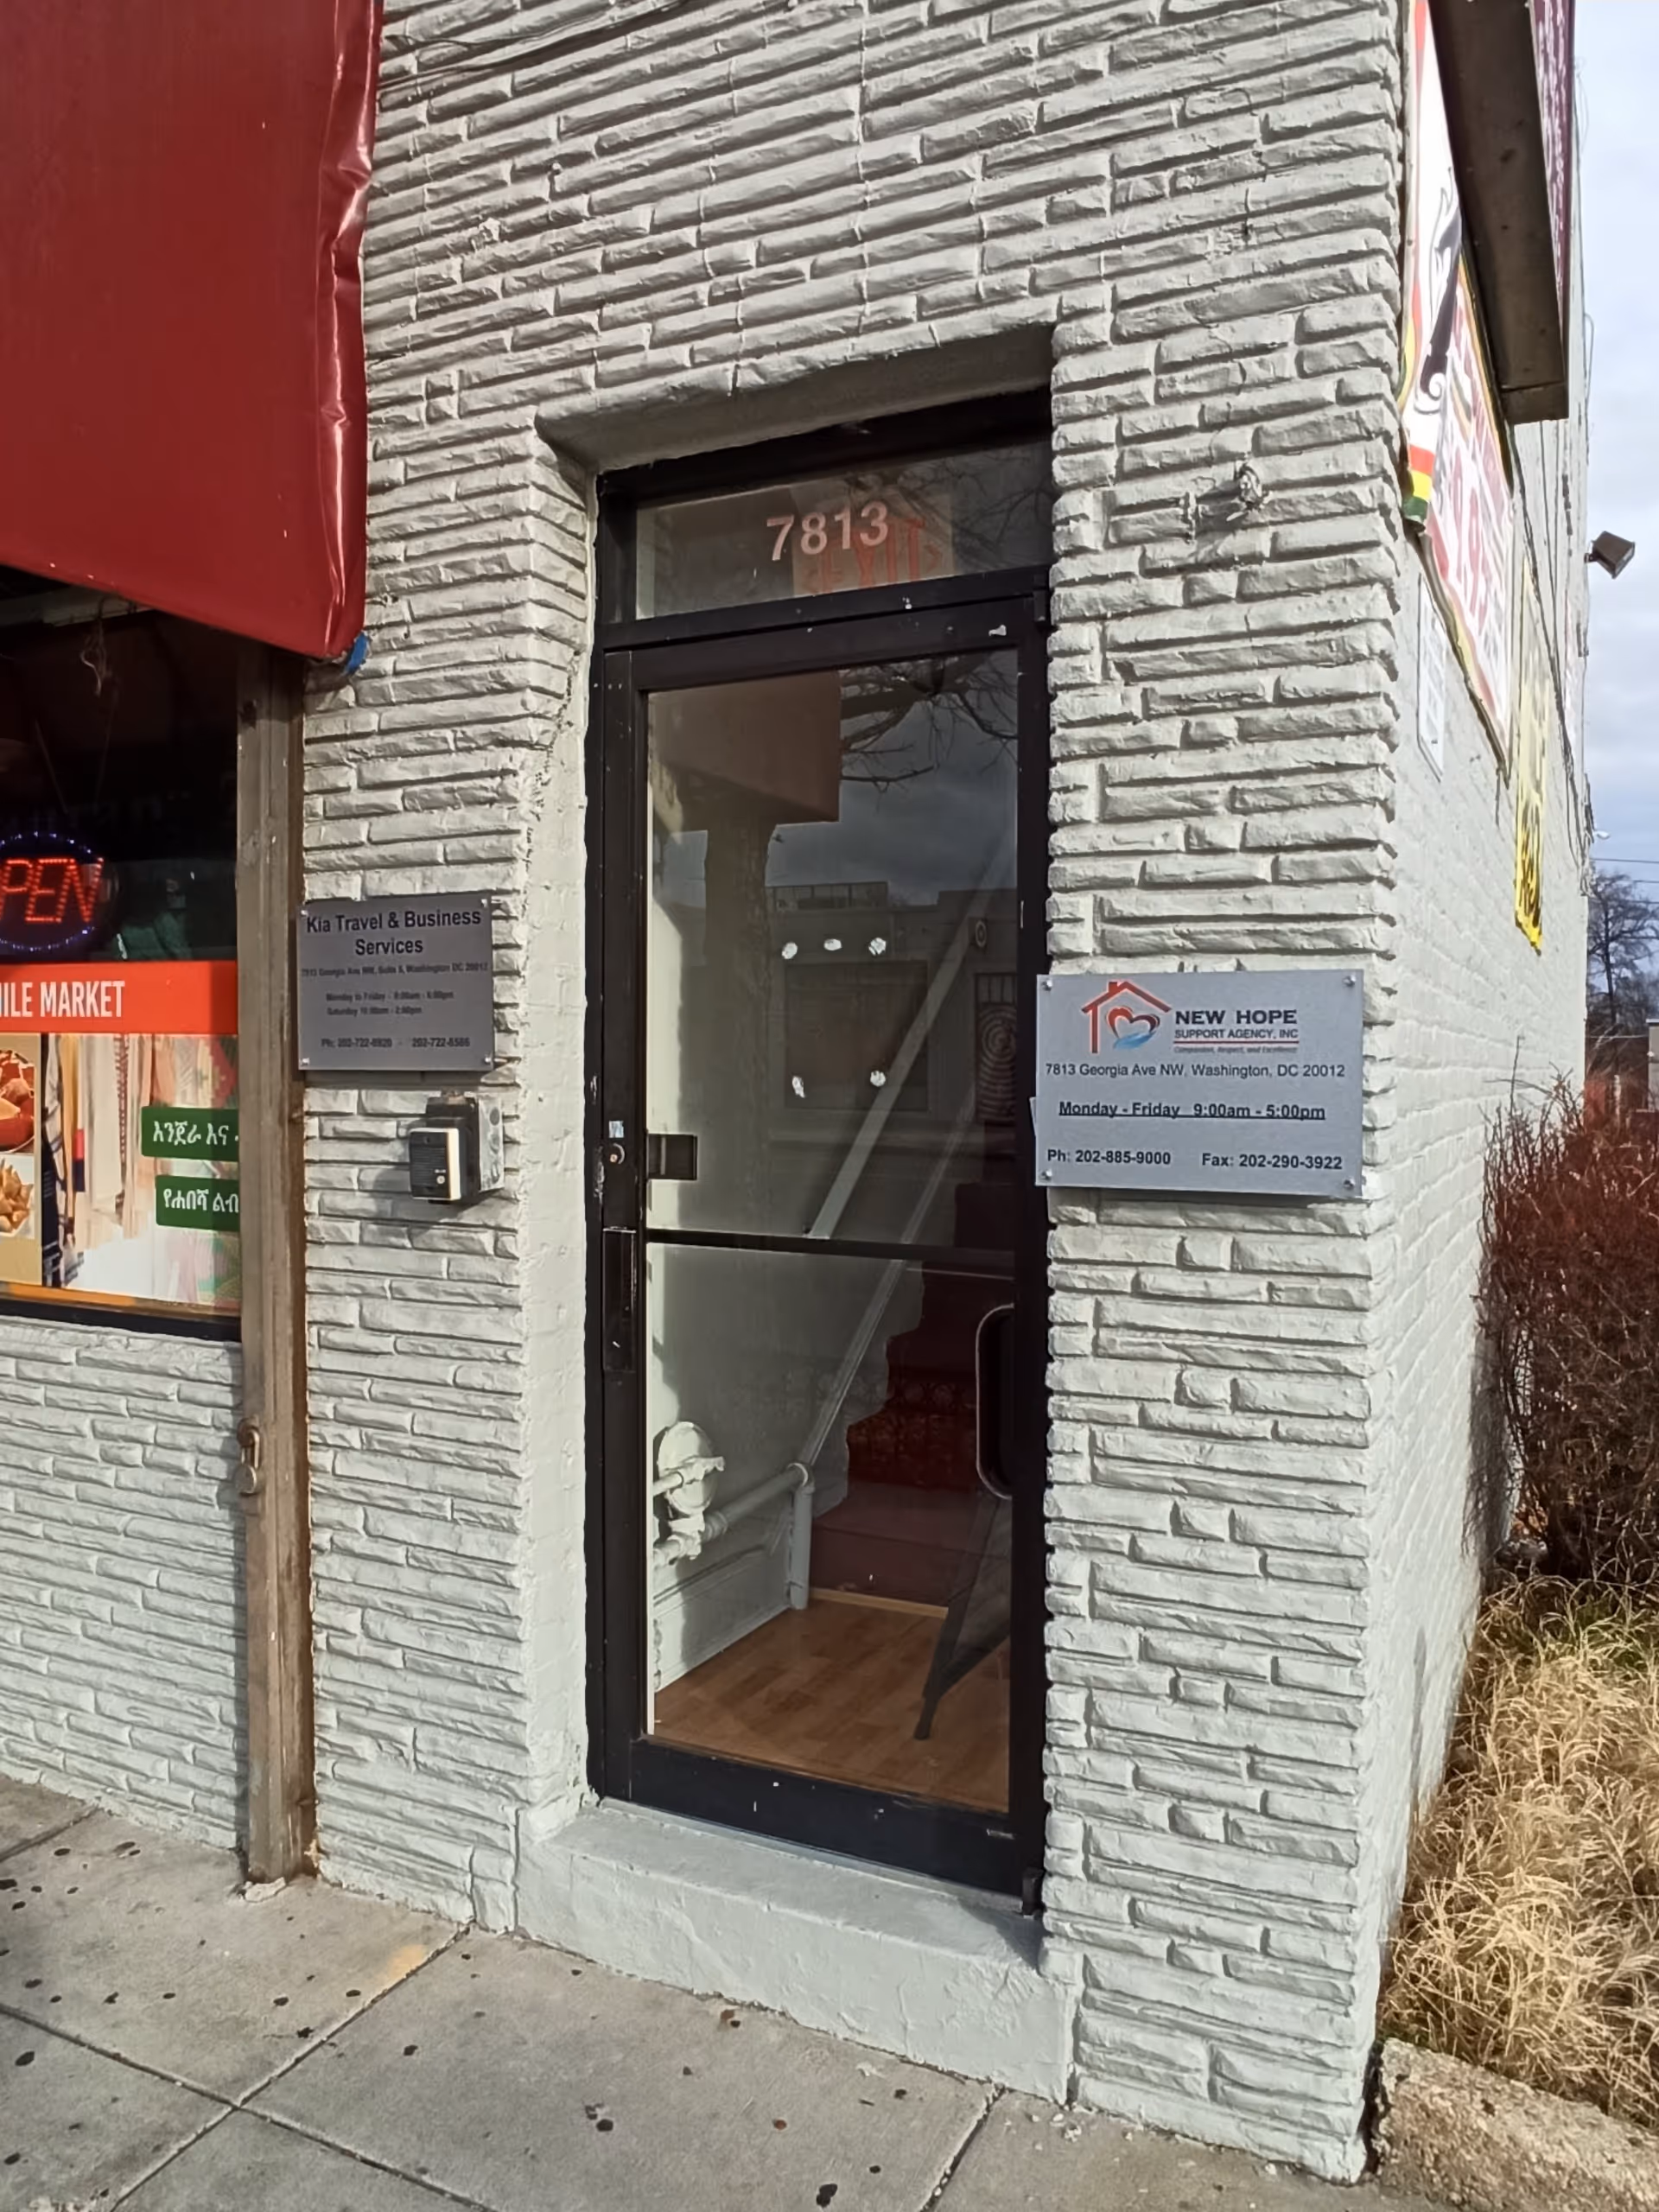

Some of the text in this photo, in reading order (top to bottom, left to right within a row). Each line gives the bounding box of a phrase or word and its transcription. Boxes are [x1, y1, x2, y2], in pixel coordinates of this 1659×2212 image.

[767, 501, 887, 561] 7813
[307, 909, 481, 932] Kia Travel & Business
[355, 938, 423, 955] Services
[0, 980, 125, 1018] ILE MARKET
[1175, 1009, 1297, 1025] NEW HOPE
[1175, 1028, 1299, 1039] SUPPORT AGENCY, INC
[1046, 1063, 1345, 1079] 7813 Georgia Ave NW, Washington, DC 20012
[1059, 1102, 1117, 1118] Monday
[1132, 1103, 1179, 1119] Friday
[1193, 1103, 1250, 1118] 9:00am
[1266, 1104, 1325, 1121] 5:00pm
[1047, 1149, 1171, 1165] Ph: 202-885-9000
[1202, 1152, 1343, 1170] Fax: 202-290-3922
